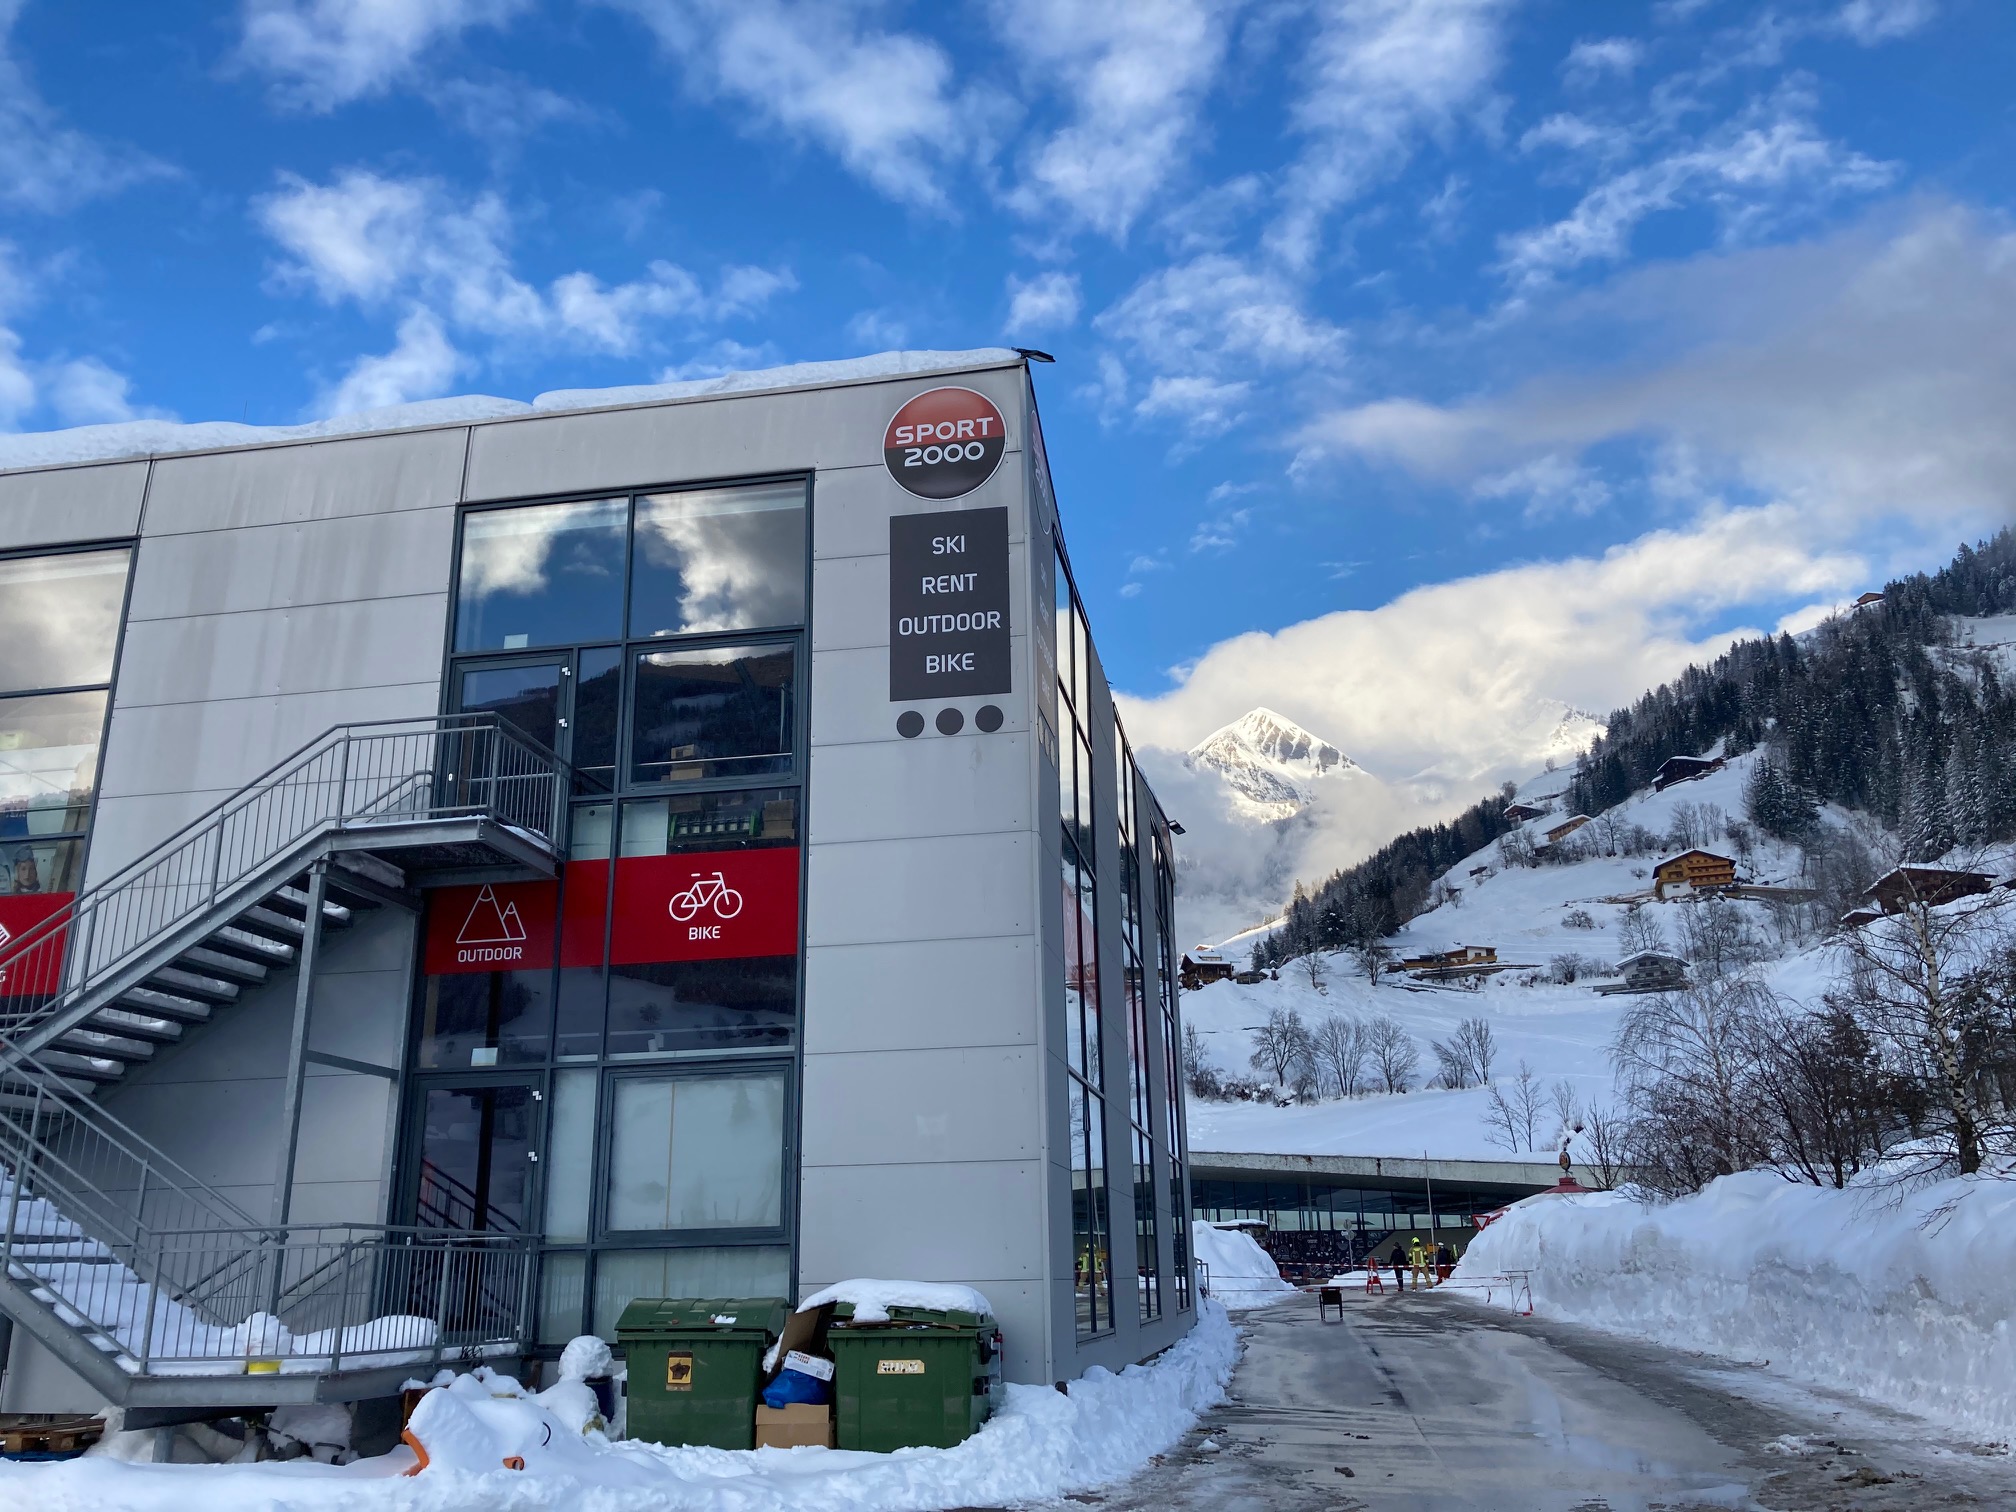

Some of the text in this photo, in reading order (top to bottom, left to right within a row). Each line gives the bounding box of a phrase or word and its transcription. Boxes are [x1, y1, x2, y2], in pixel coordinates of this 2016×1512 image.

[895, 417, 993, 445] SPORT
[904, 441, 985, 467] 2000
[932, 535, 965, 555] SKI
[922, 573, 977, 594] RENT
[898, 610, 1001, 635] OUTDOOR
[926, 652, 975, 673] BIKE
[689, 925, 721, 940] BIKE
[458, 947, 522, 962] OUTDOOR
